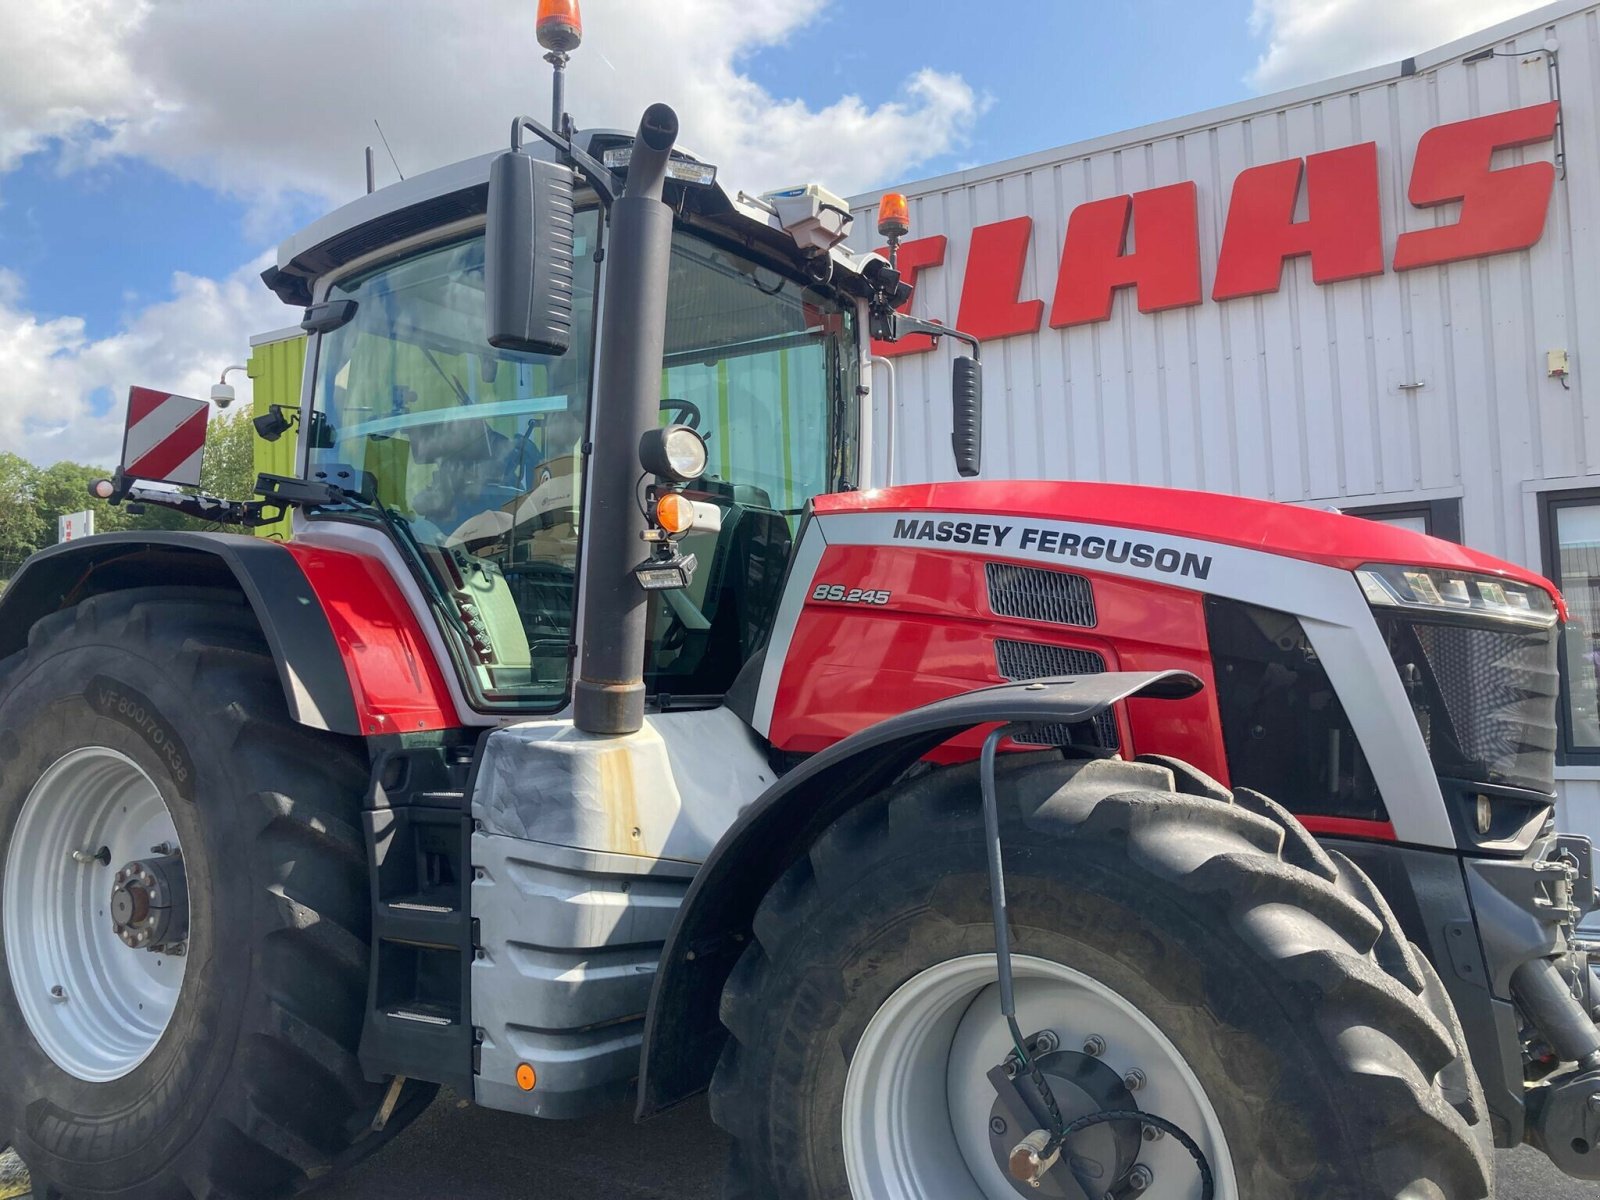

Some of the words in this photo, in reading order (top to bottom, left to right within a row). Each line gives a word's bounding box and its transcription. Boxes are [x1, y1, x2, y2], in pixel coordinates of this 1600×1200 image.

[893, 519, 1013, 546] MASSEY
[1019, 528, 1213, 580] FERGUSON
[812, 582, 892, 605] 8S.245
[98, 687, 119, 707] VF
[118, 695, 165, 744] 800/70
[162, 740, 188, 782] R38
